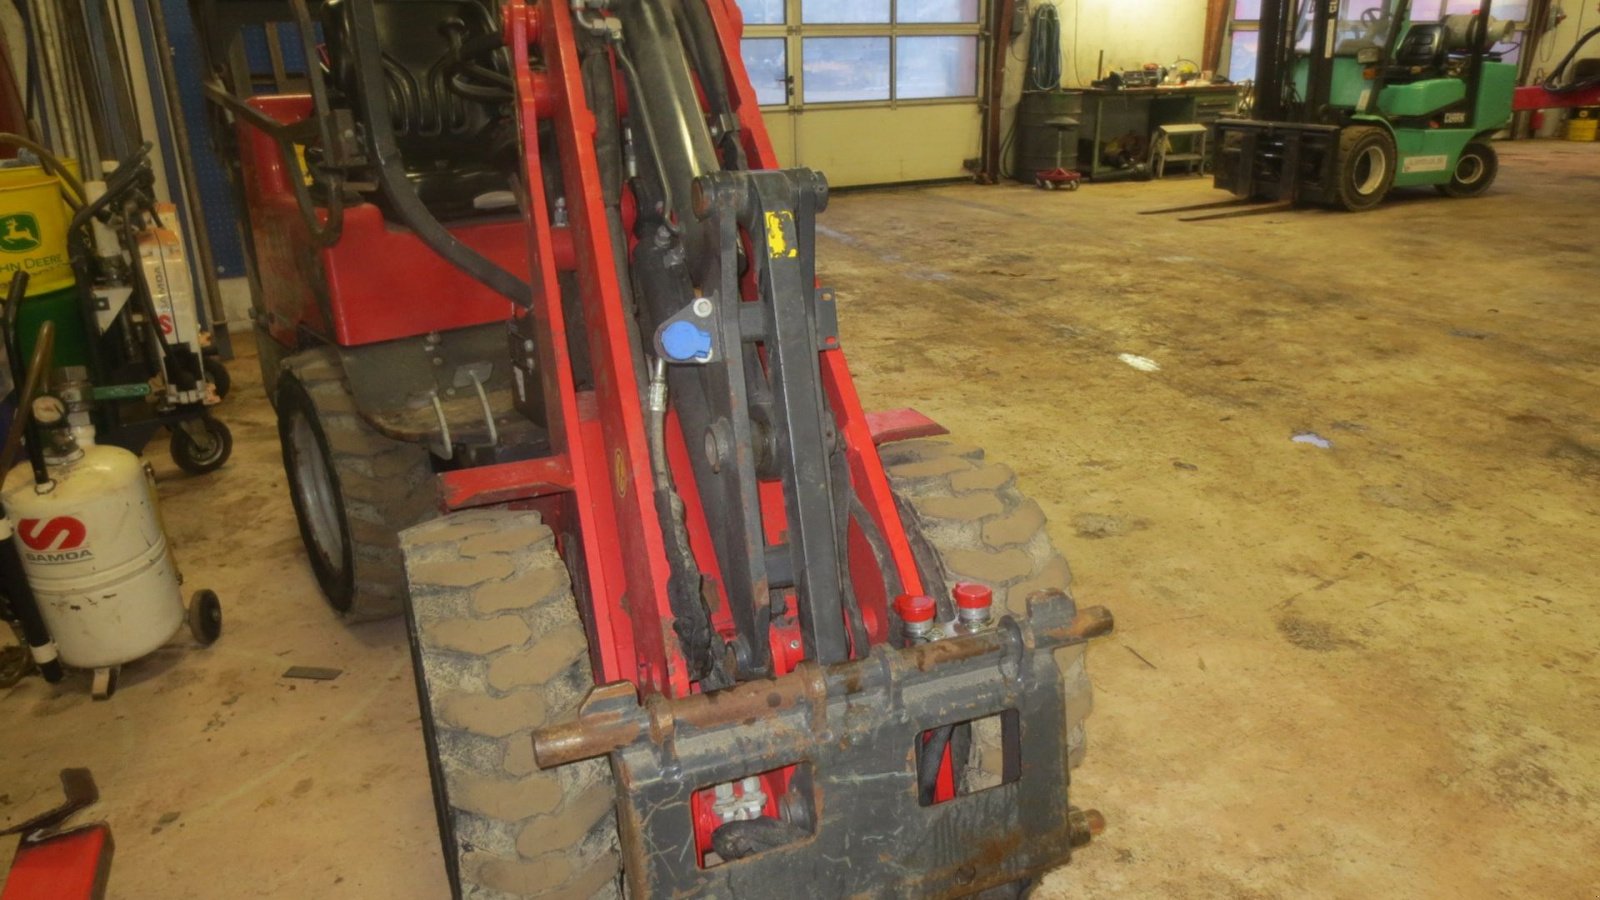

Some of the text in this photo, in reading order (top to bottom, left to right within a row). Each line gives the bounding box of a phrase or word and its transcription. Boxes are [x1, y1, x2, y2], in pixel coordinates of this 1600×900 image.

[0, 263, 21, 272] HN
[24, 254, 62, 269] DEERE
[25, 549, 93, 561] SAMOA
